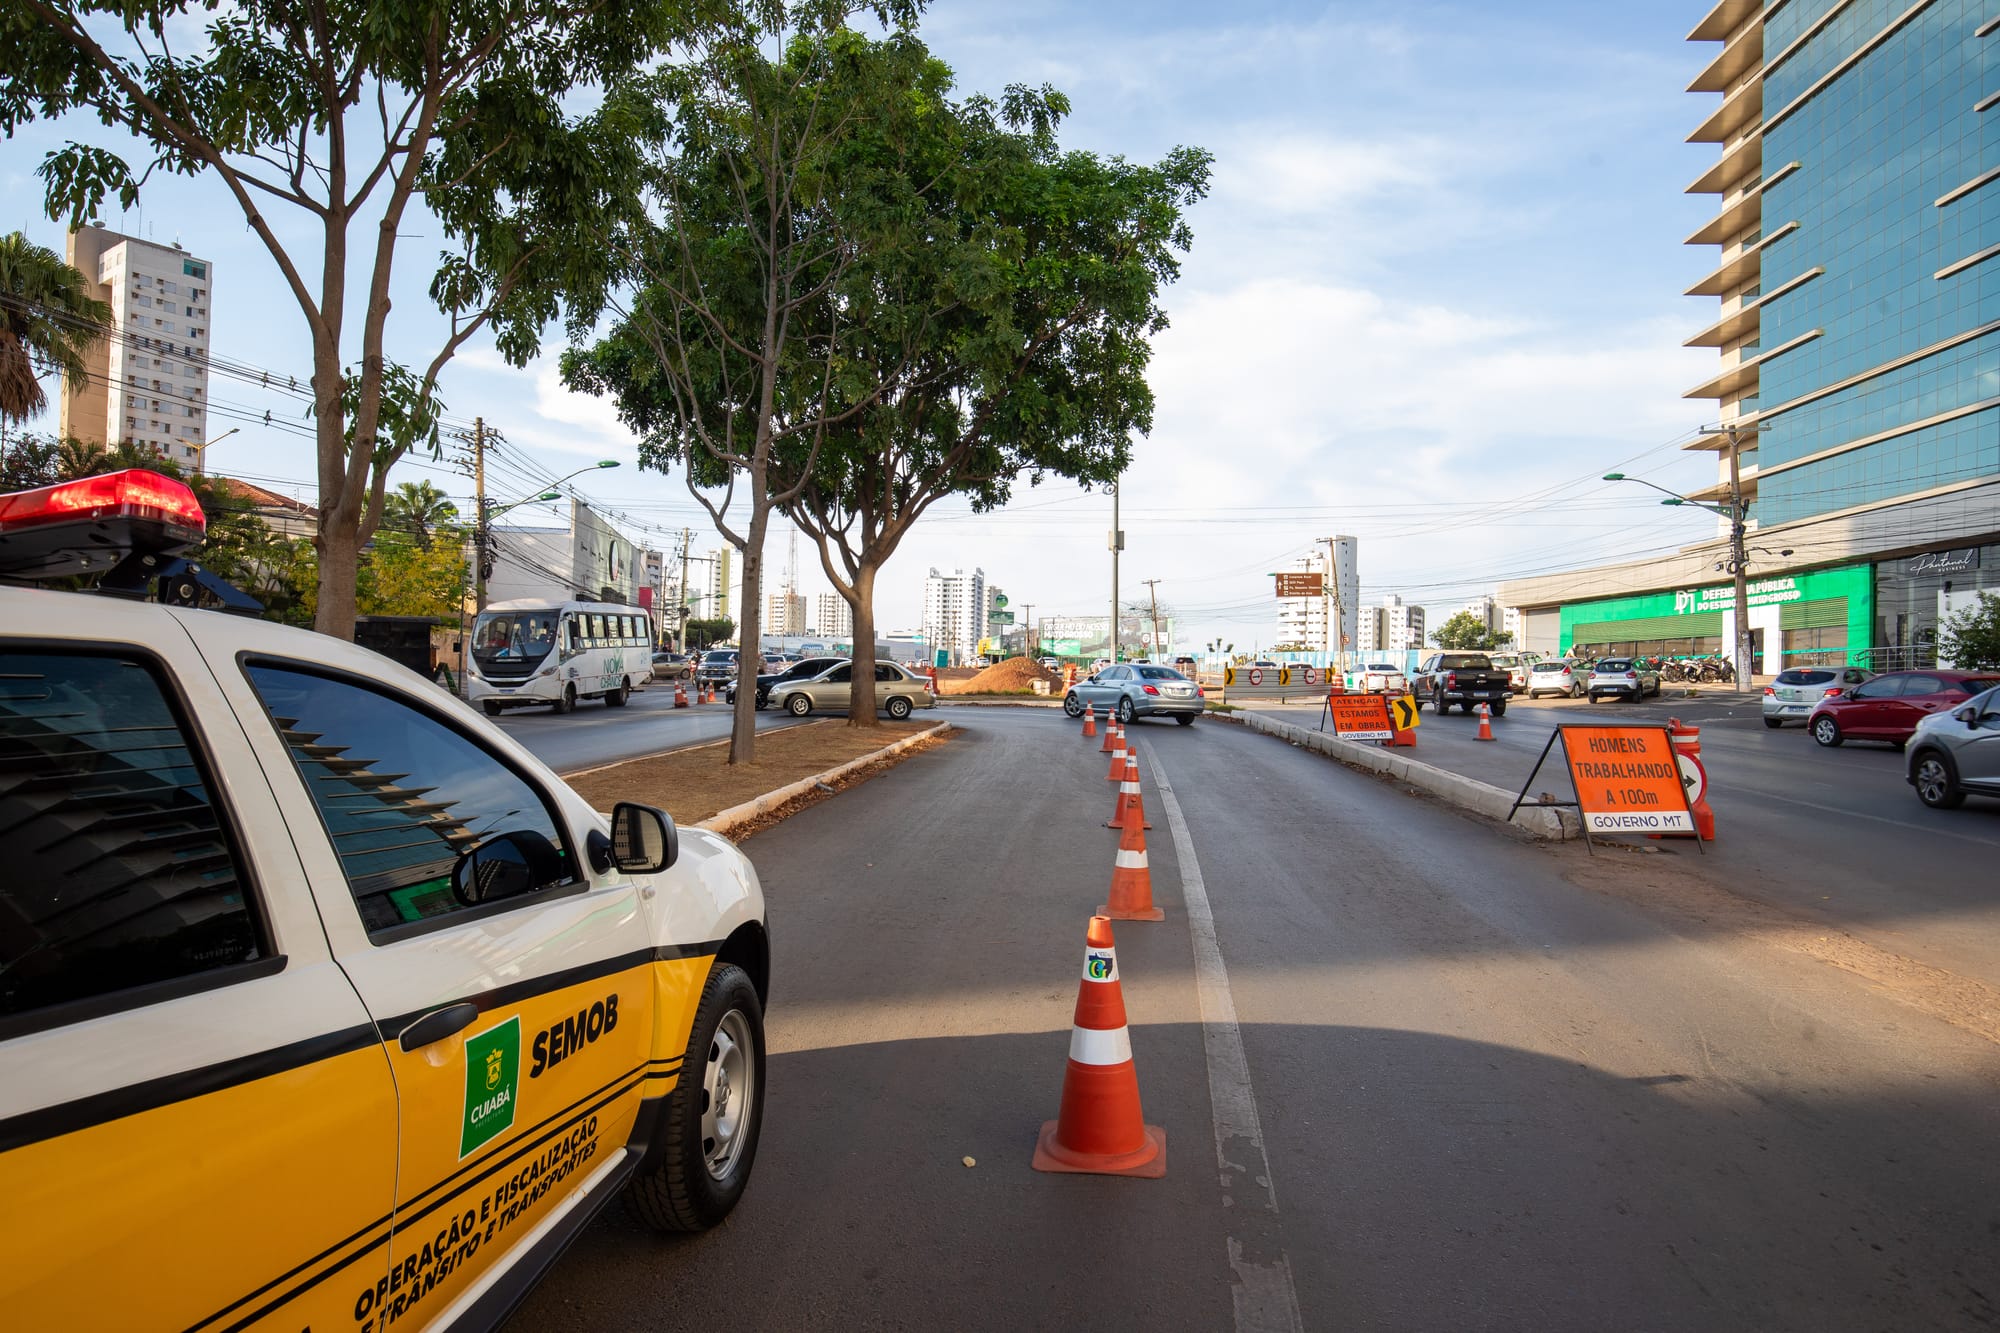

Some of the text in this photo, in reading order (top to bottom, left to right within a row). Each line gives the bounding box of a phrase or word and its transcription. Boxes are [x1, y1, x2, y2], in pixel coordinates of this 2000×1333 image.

[1909, 548, 1974, 576] Pantanal
[1756, 578, 1795, 594] PÚBLICA
[1697, 602, 1708, 611] DO
[1340, 710, 1380, 718] ESTAMOS
[1340, 721, 1386, 730] EM OBRAS
[1588, 737, 1647, 753] HOMENS
[1576, 762, 1674, 779] TRABALHANDO
[1606, 788, 1659, 805] A 100m
[1594, 815, 1682, 828] GOVERNO MT
[529, 993, 619, 1079] SEMOB
[471, 1084, 511, 1124] CUIABÁ
[355, 1115, 598, 1322] OPERAÇÃO E FISCALIZAÇÃO
[379, 1231, 481, 1333] TRÂNSITO
[484, 1223, 496, 1245] E
[497, 1134, 600, 1232] TRANSPORTES
